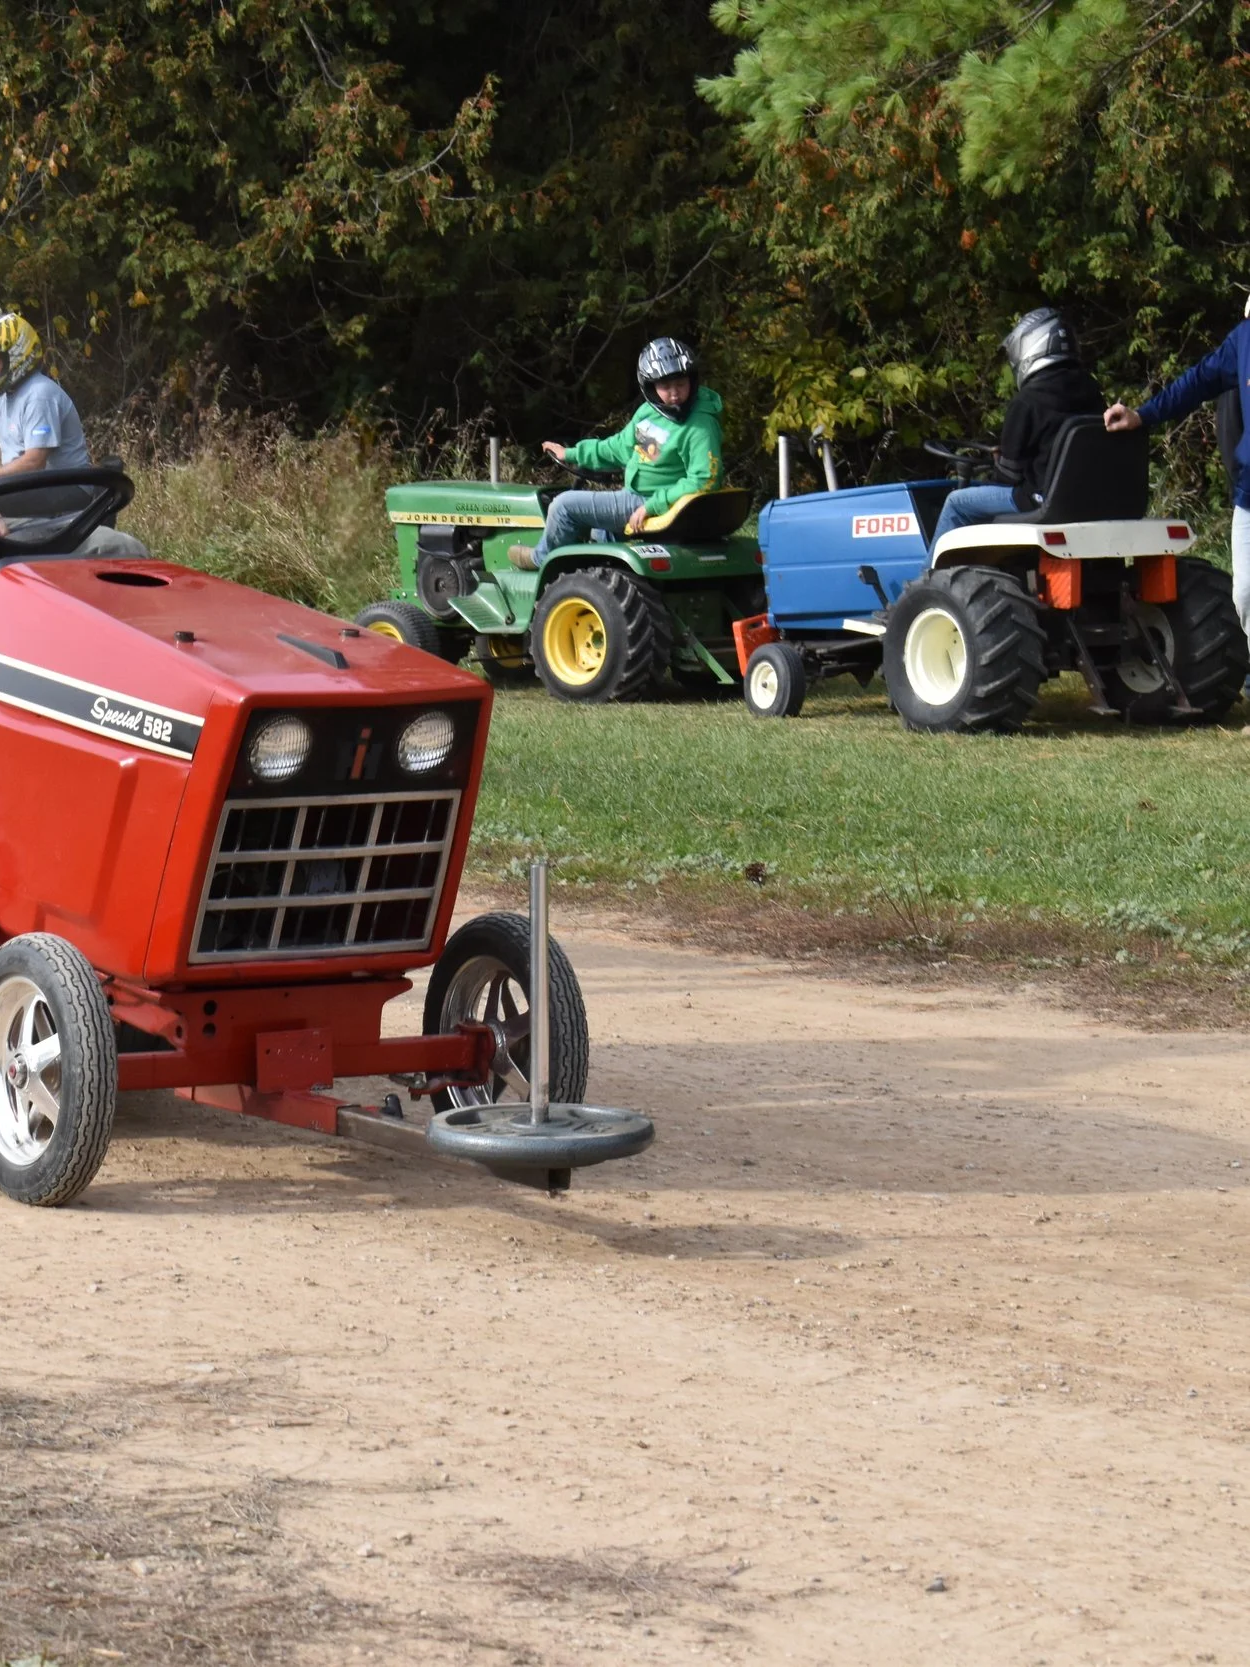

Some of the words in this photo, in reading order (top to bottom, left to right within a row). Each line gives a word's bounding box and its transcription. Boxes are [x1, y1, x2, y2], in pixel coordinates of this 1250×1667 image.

[407, 513, 437, 522] JOHN
[441, 515, 482, 524] DEERE
[855, 516, 910, 535] FORD
[90, 697, 141, 731] Special
[142, 716, 174, 744] 582
